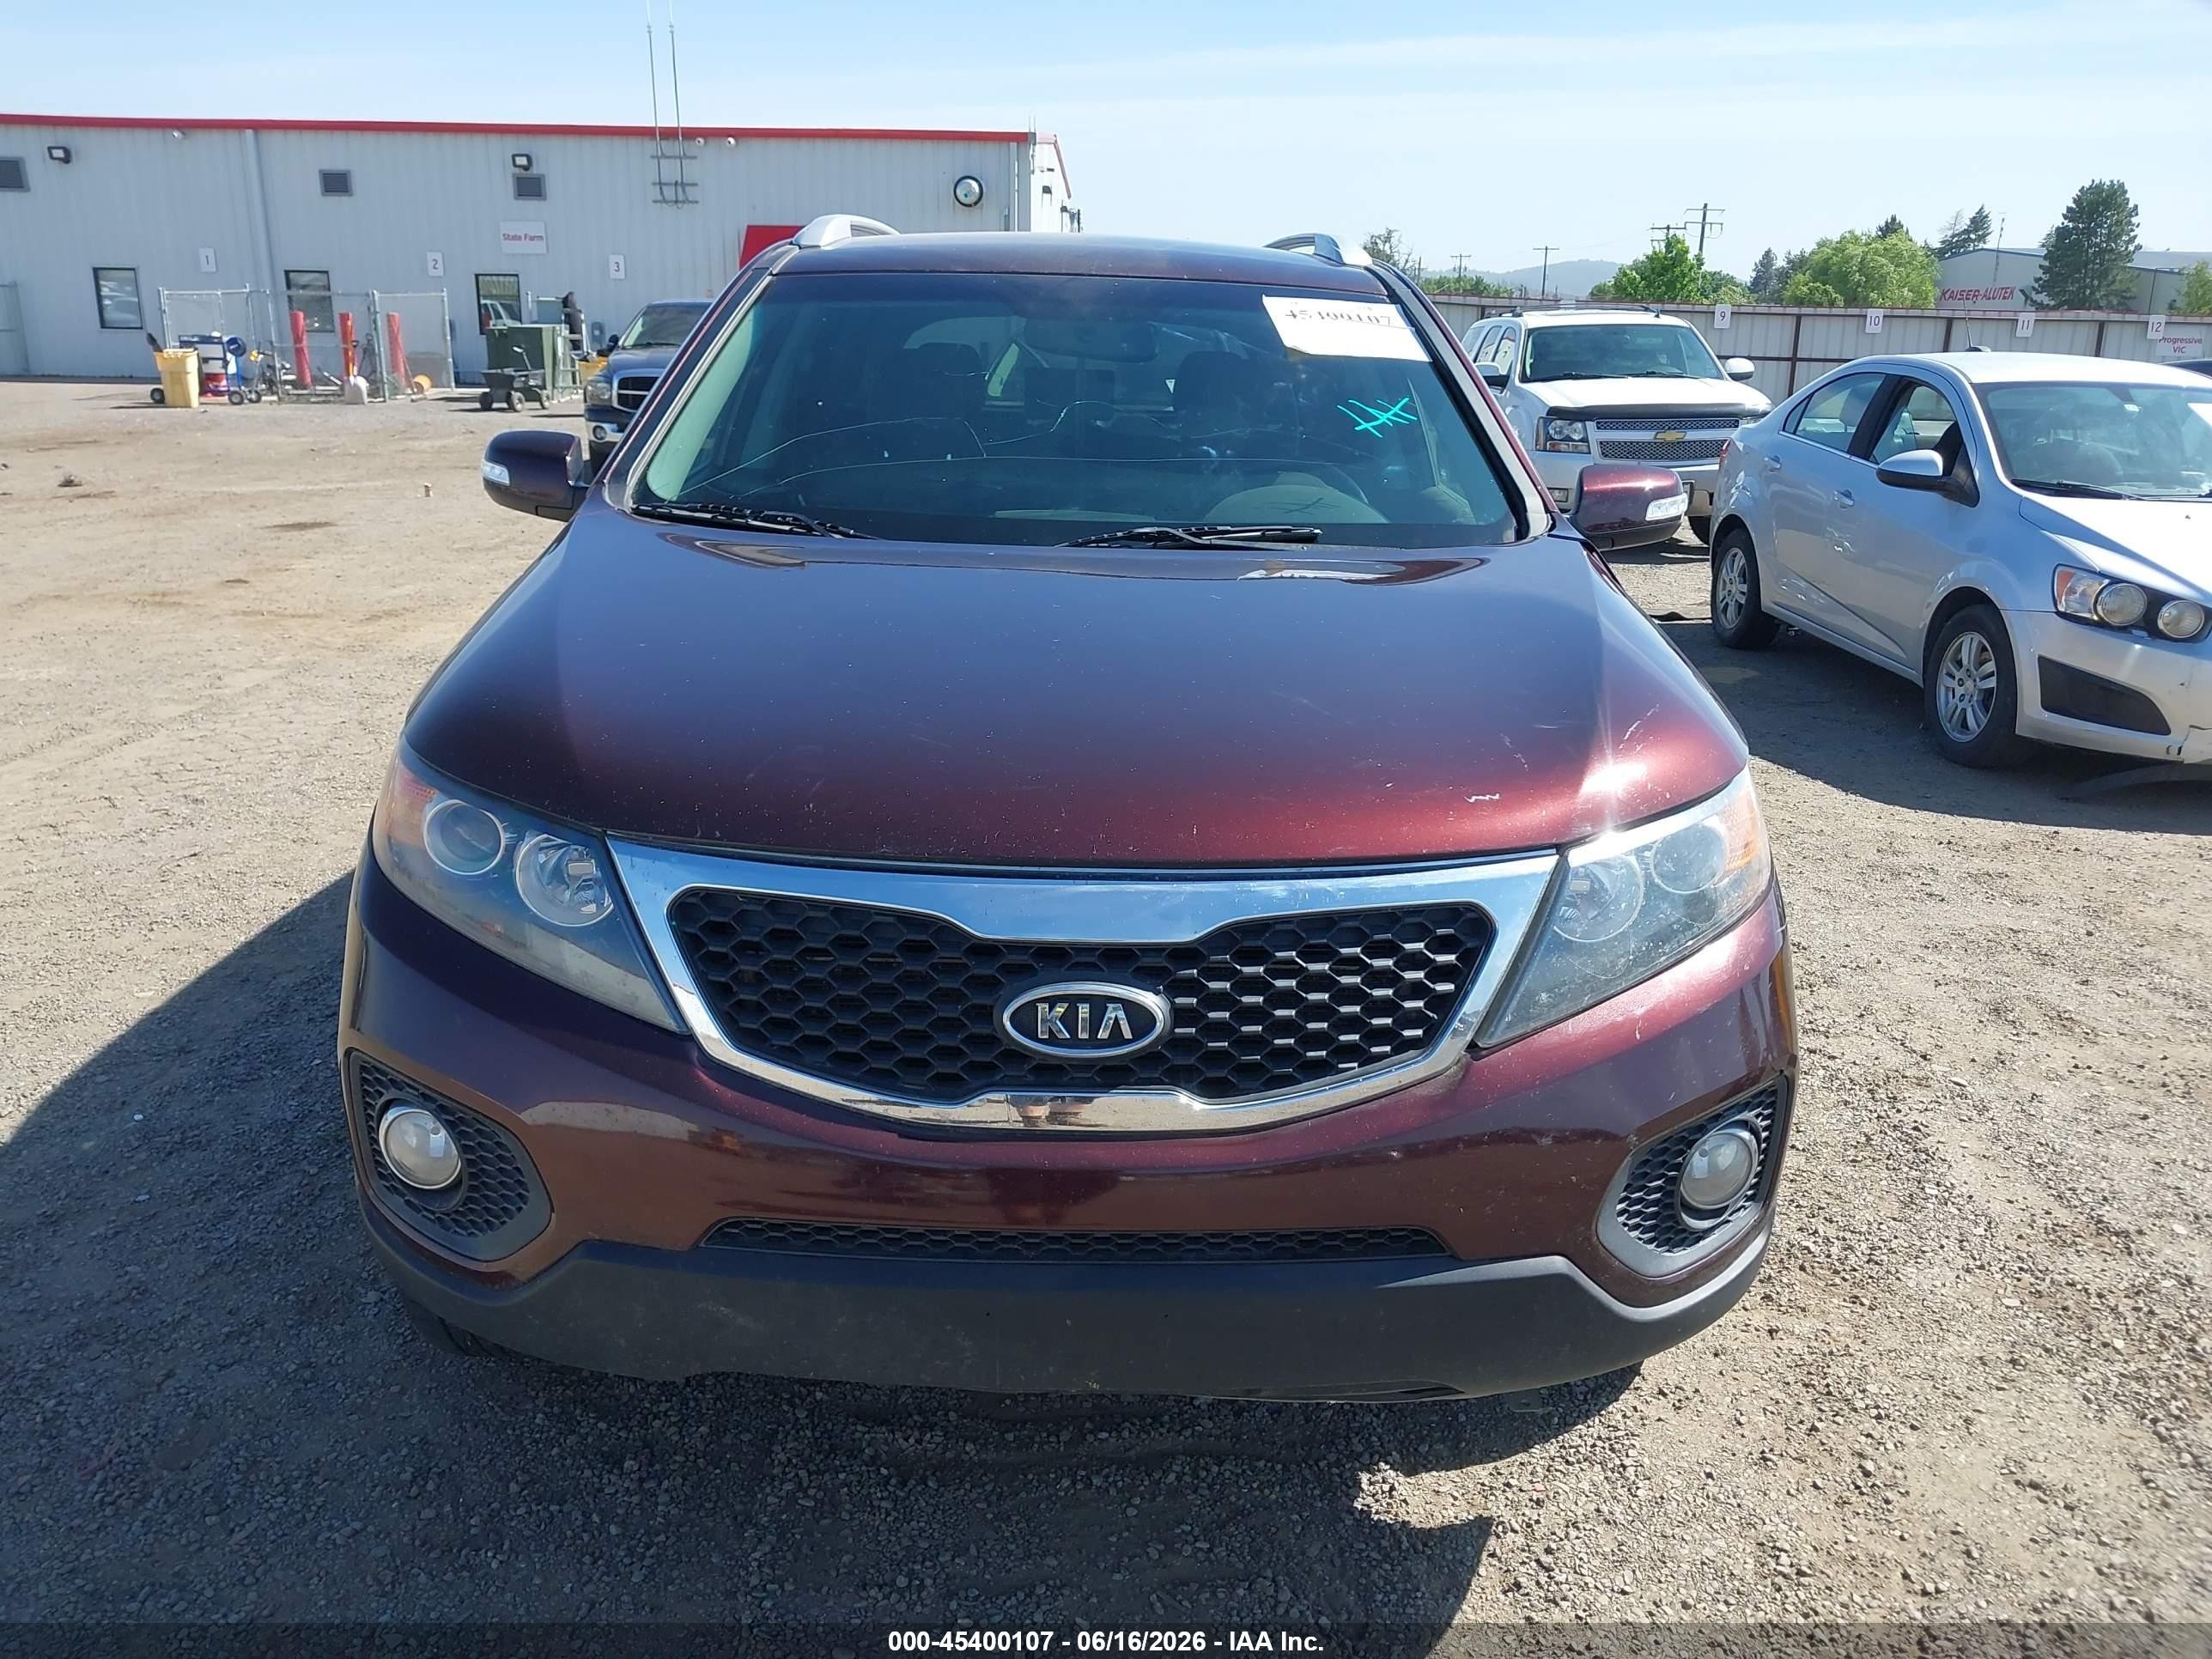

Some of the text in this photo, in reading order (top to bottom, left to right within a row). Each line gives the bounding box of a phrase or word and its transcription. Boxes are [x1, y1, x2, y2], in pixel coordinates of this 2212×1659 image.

[501, 233, 544, 241] State Farm
[431, 258, 439, 270] 2
[613, 261, 620, 272] 3
[1940, 287, 2015, 301] KAISER-ALUTEK
[1719, 310, 1726, 321] 9
[1869, 315, 1881, 326] 10
[2020, 319, 2030, 331] 11
[2150, 321, 2162, 333] 12
[2158, 336, 2203, 345] Progressive
[2172, 345, 2186, 354] VIC
[1036, 1002, 1133, 1040] KIA
